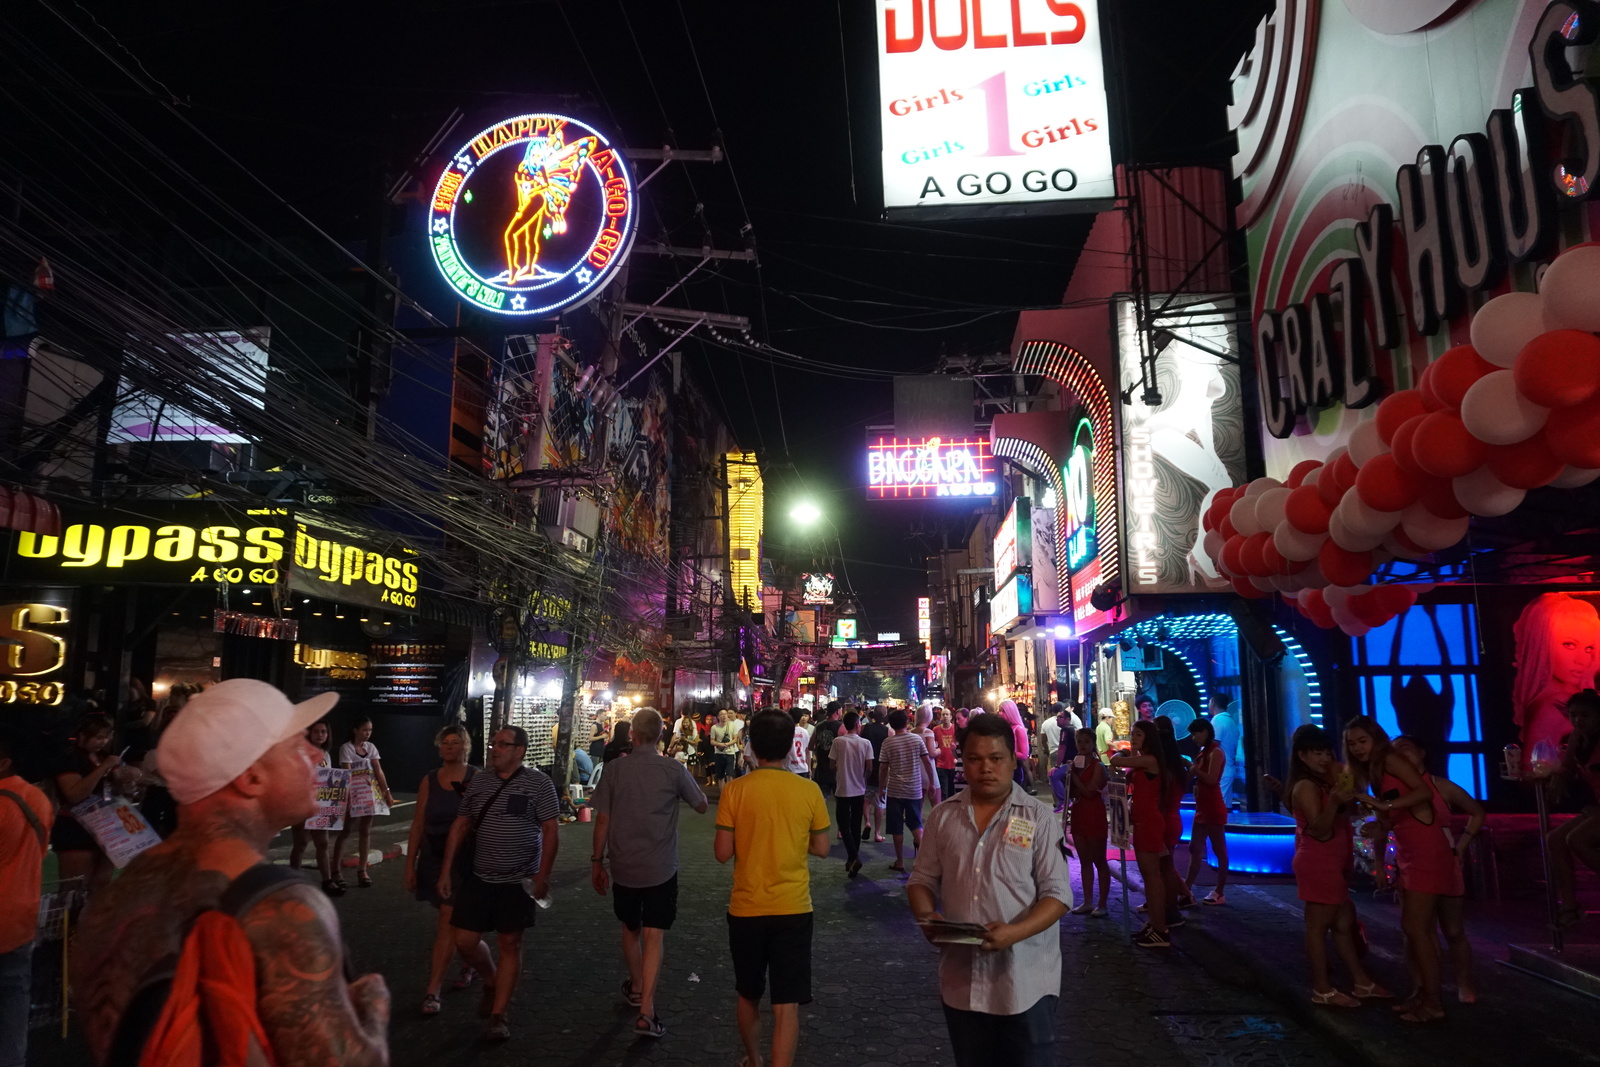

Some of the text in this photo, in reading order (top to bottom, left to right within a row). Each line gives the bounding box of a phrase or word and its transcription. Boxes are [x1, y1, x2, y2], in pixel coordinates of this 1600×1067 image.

[884, 0, 1087, 54] DOLLS
[1022, 74, 1087, 97] Girls
[888, 88, 964, 117] Girls
[970, 71, 1028, 157] 1
[471, 117, 567, 159] HAPPY
[1021, 117, 1099, 148] Girls
[901, 140, 965, 165] Girls
[919, 168, 1078, 199] A GO GO
[1258, 204, 1399, 439] CRAZY
[1131, 427, 1158, 585] SHOWGIRLS
[294, 523, 419, 594] bypass
[190, 566, 279, 584] A GO GO
[380, 588, 417, 609] A GO GO
[795, 740, 803, 758] 2
